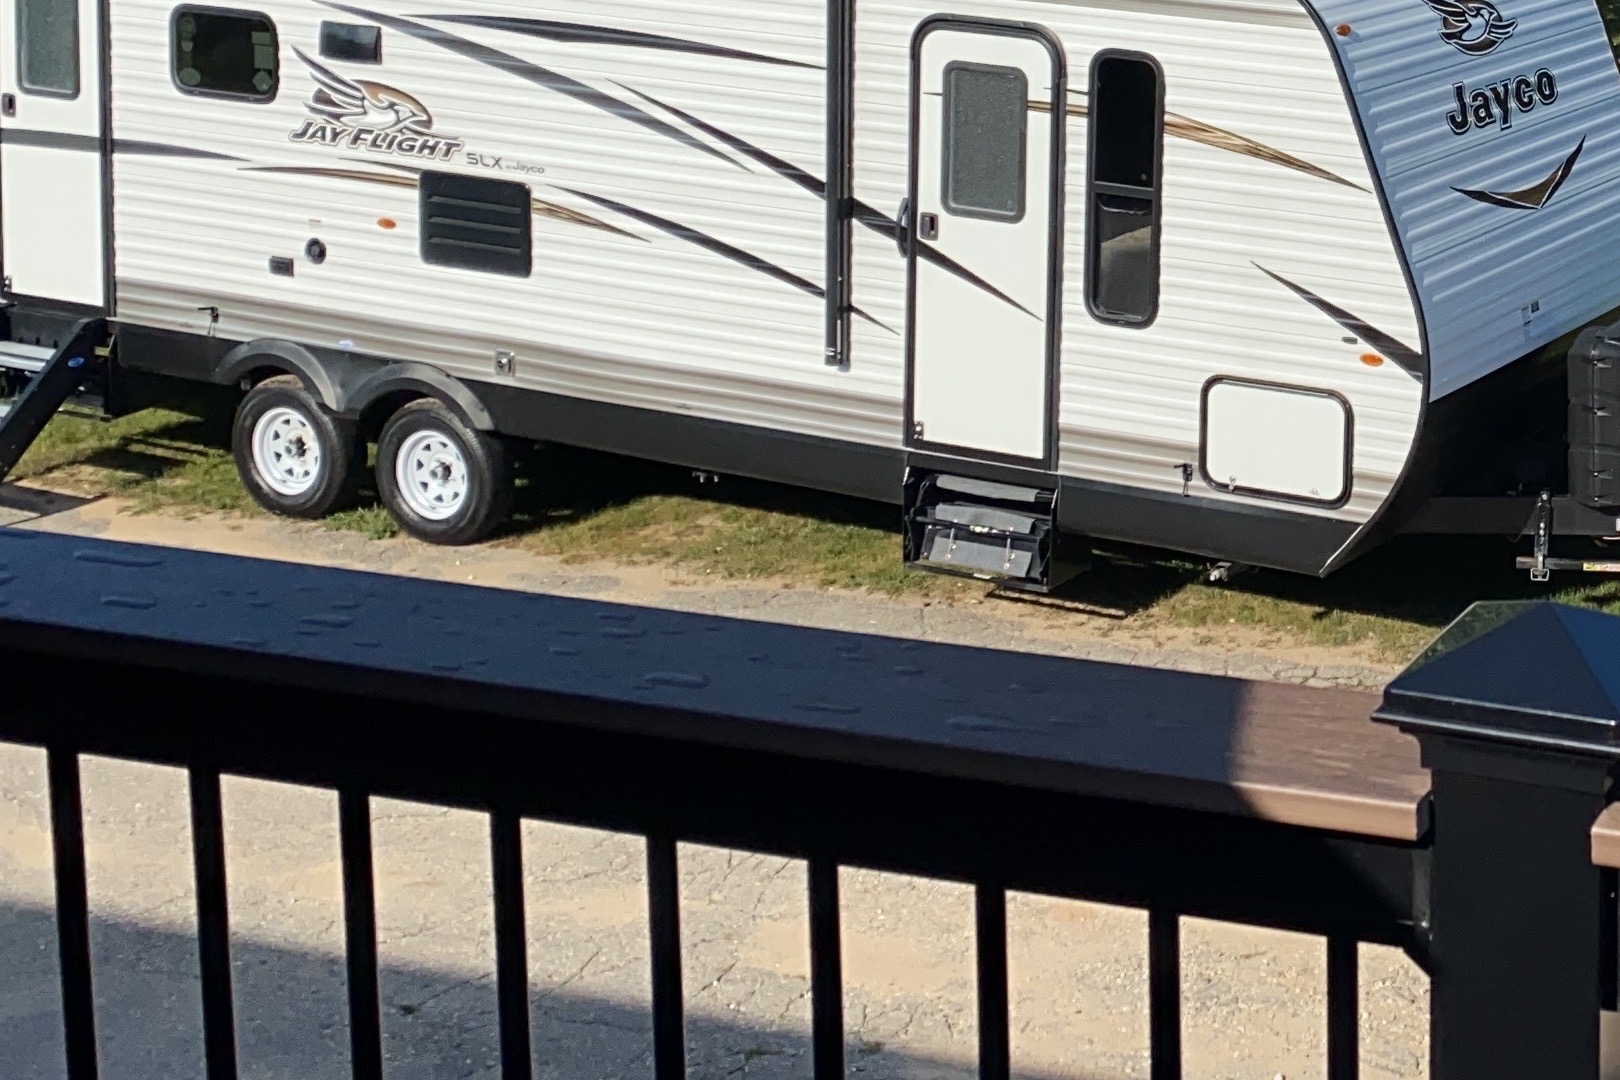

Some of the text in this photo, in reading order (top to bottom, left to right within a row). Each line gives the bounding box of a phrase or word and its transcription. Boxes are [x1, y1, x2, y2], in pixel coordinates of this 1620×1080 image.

[1446, 68, 1559, 135] Jayco
[290, 119, 349, 145] JAY
[349, 126, 464, 160] FLIGHT
[466, 152, 503, 170] SLX
